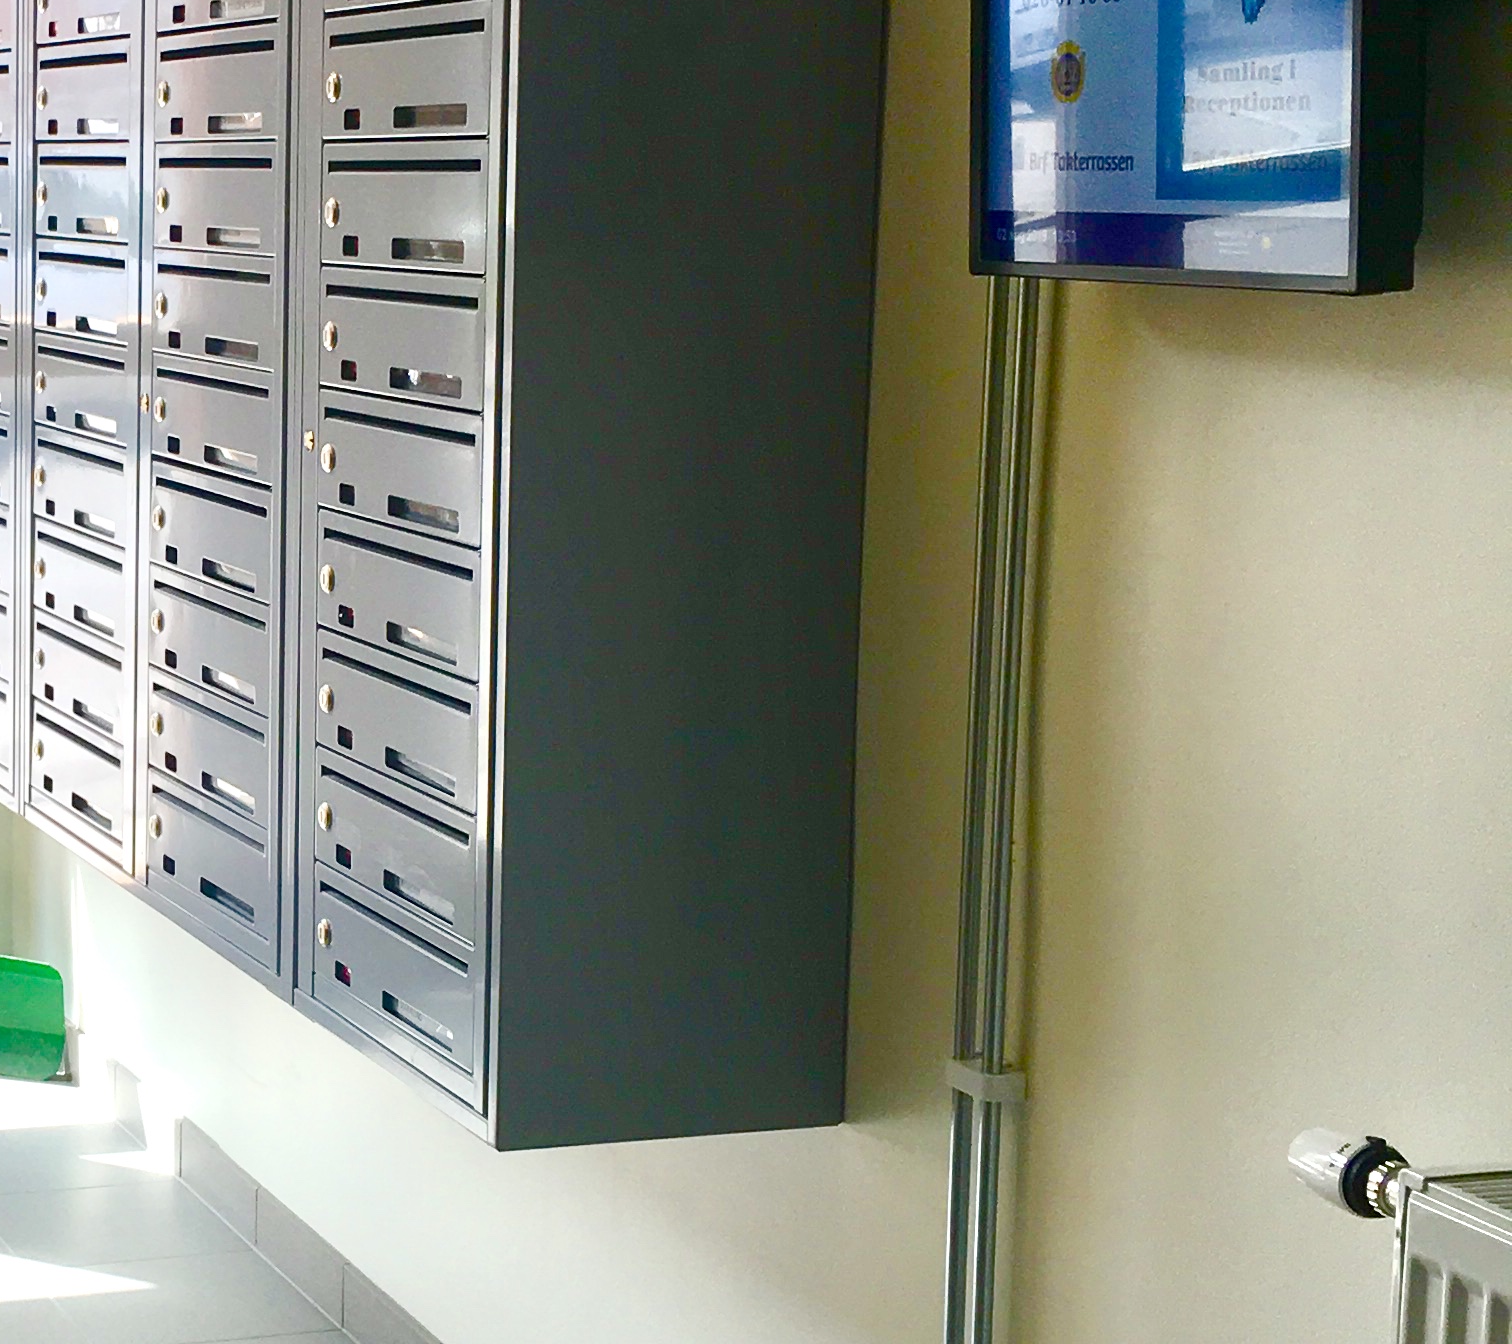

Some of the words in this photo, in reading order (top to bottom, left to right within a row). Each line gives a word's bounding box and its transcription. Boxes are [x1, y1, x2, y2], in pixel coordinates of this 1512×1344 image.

[1197, 59, 1284, 85] Samling
[1183, 91, 1312, 117] Receptionen
[1053, 152, 1135, 173] Takterrassen
